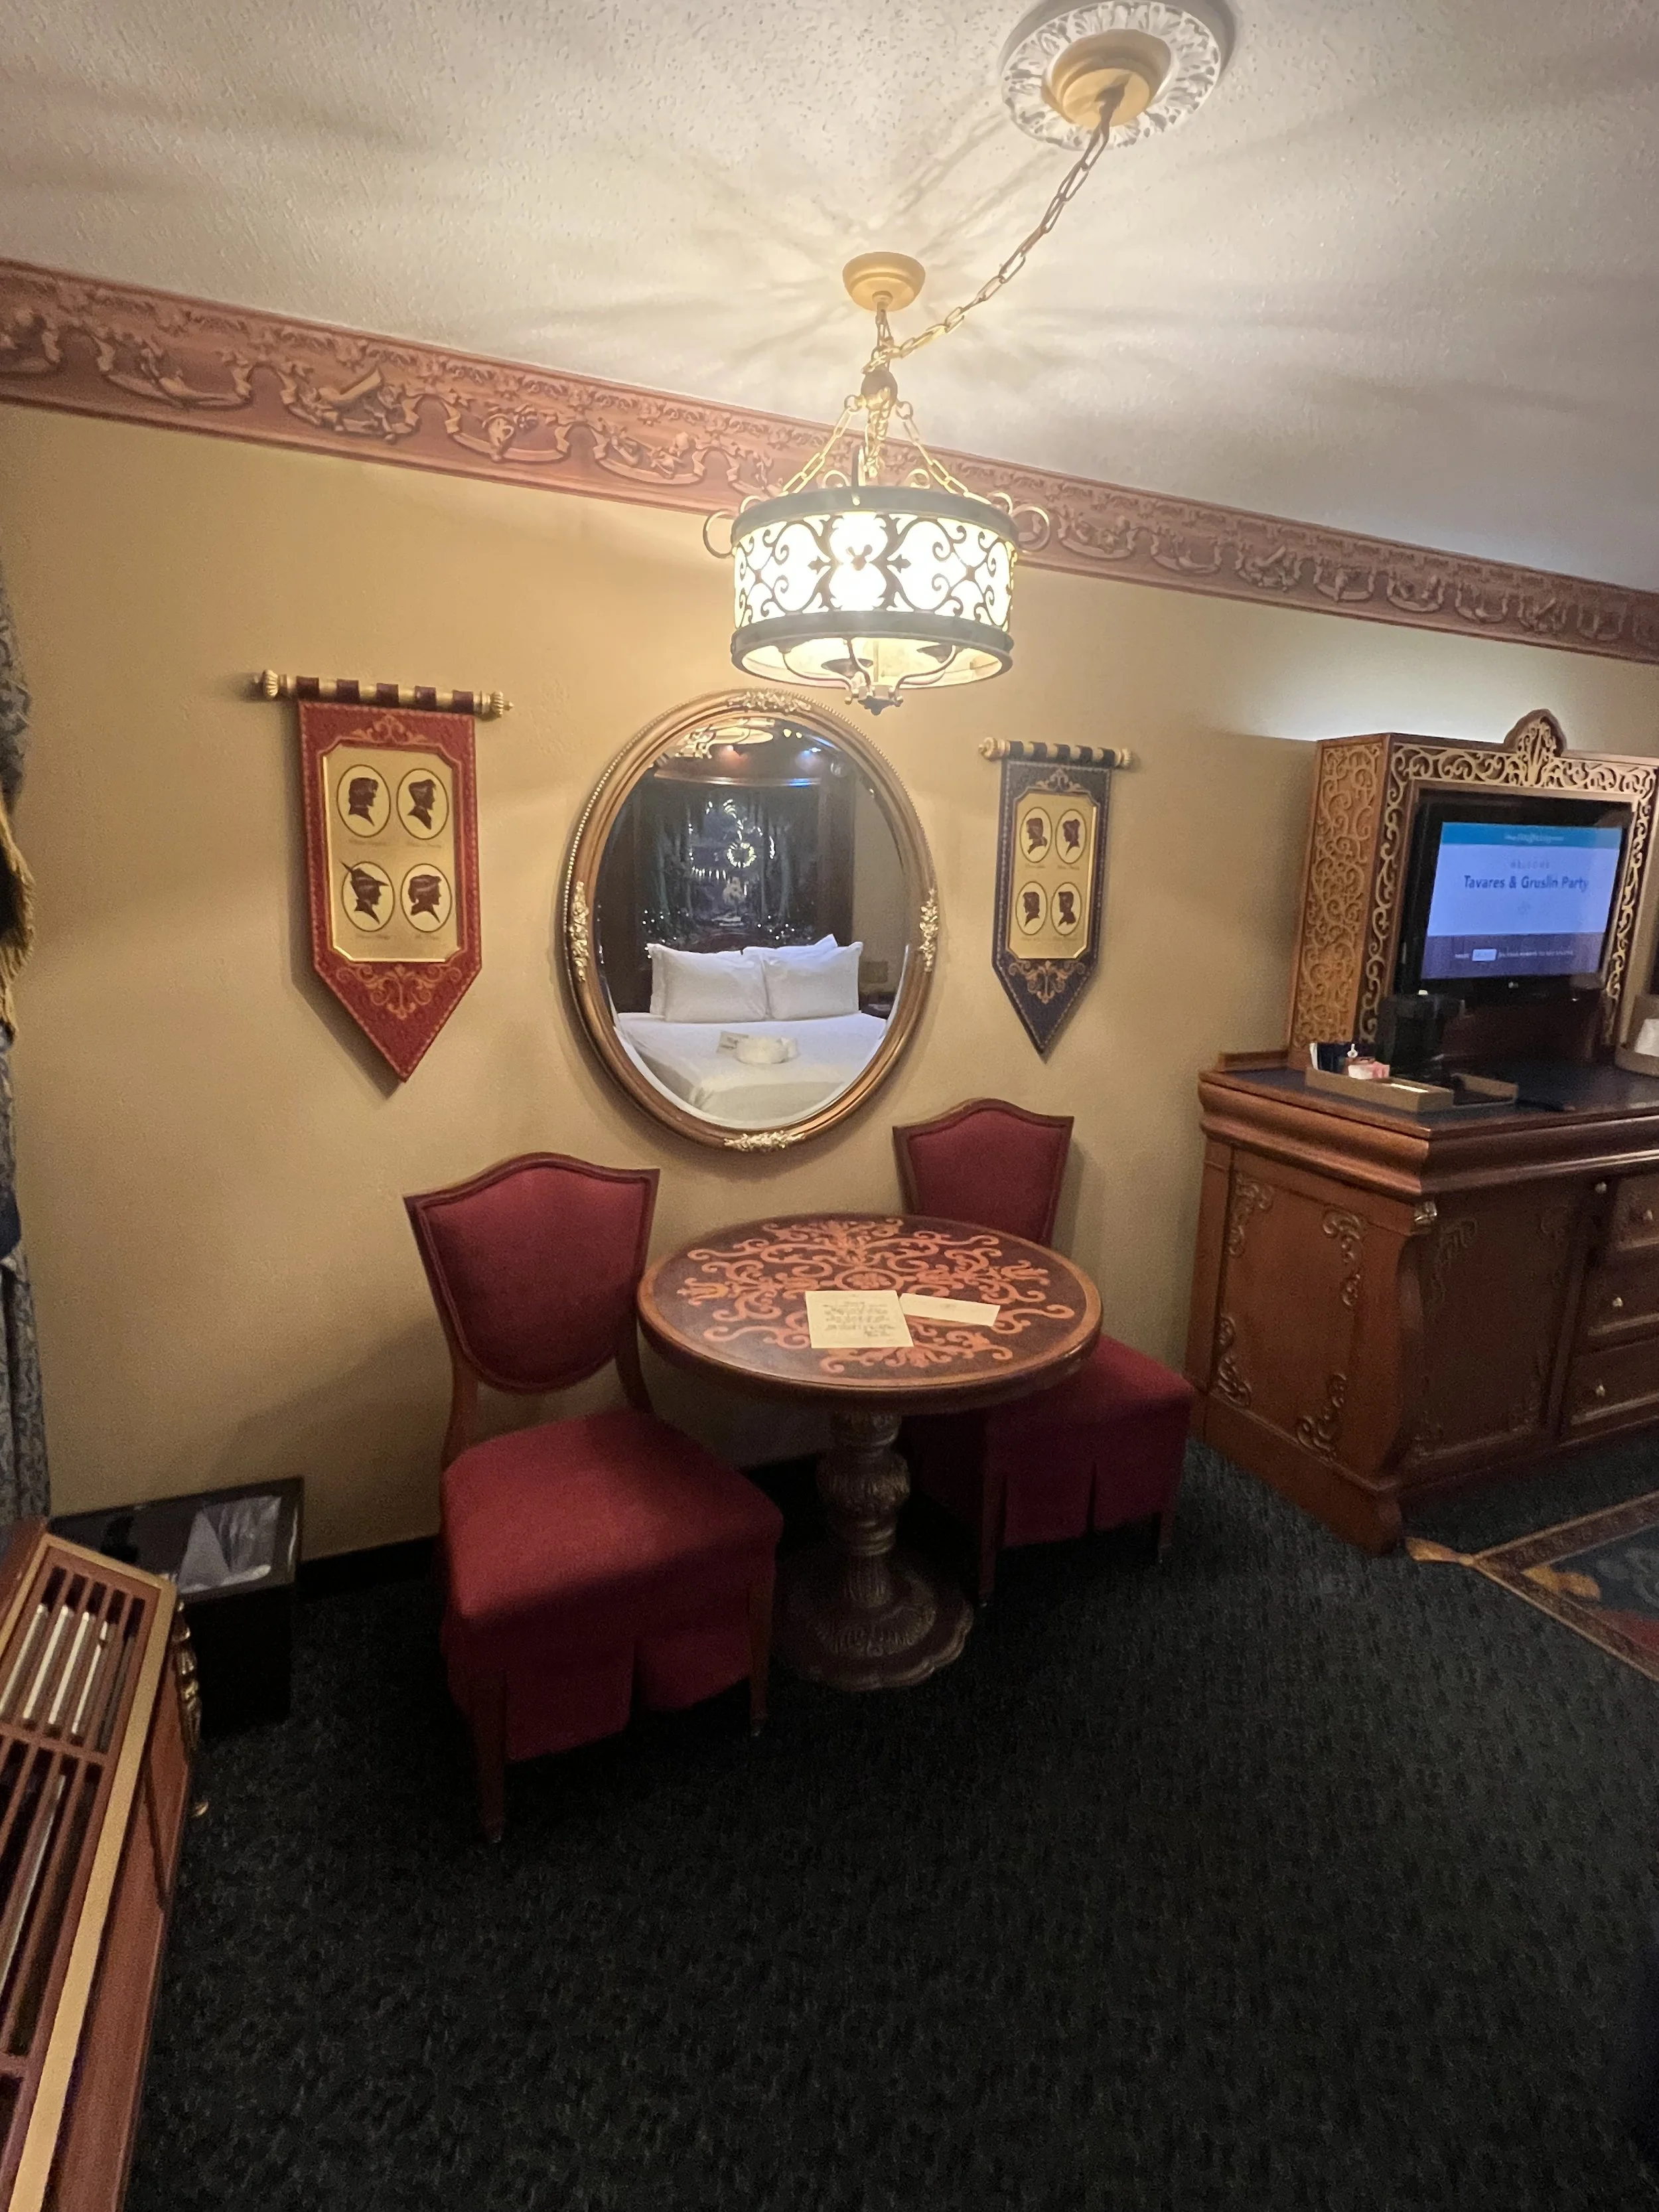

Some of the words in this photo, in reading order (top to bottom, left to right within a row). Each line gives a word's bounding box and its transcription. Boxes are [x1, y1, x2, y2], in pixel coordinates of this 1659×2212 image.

[1464, 875, 1505, 889] Tavares
[1509, 875, 1517, 889] &
[1521, 875, 1558, 889] Gruslin
[1562, 876, 1589, 893] Party
